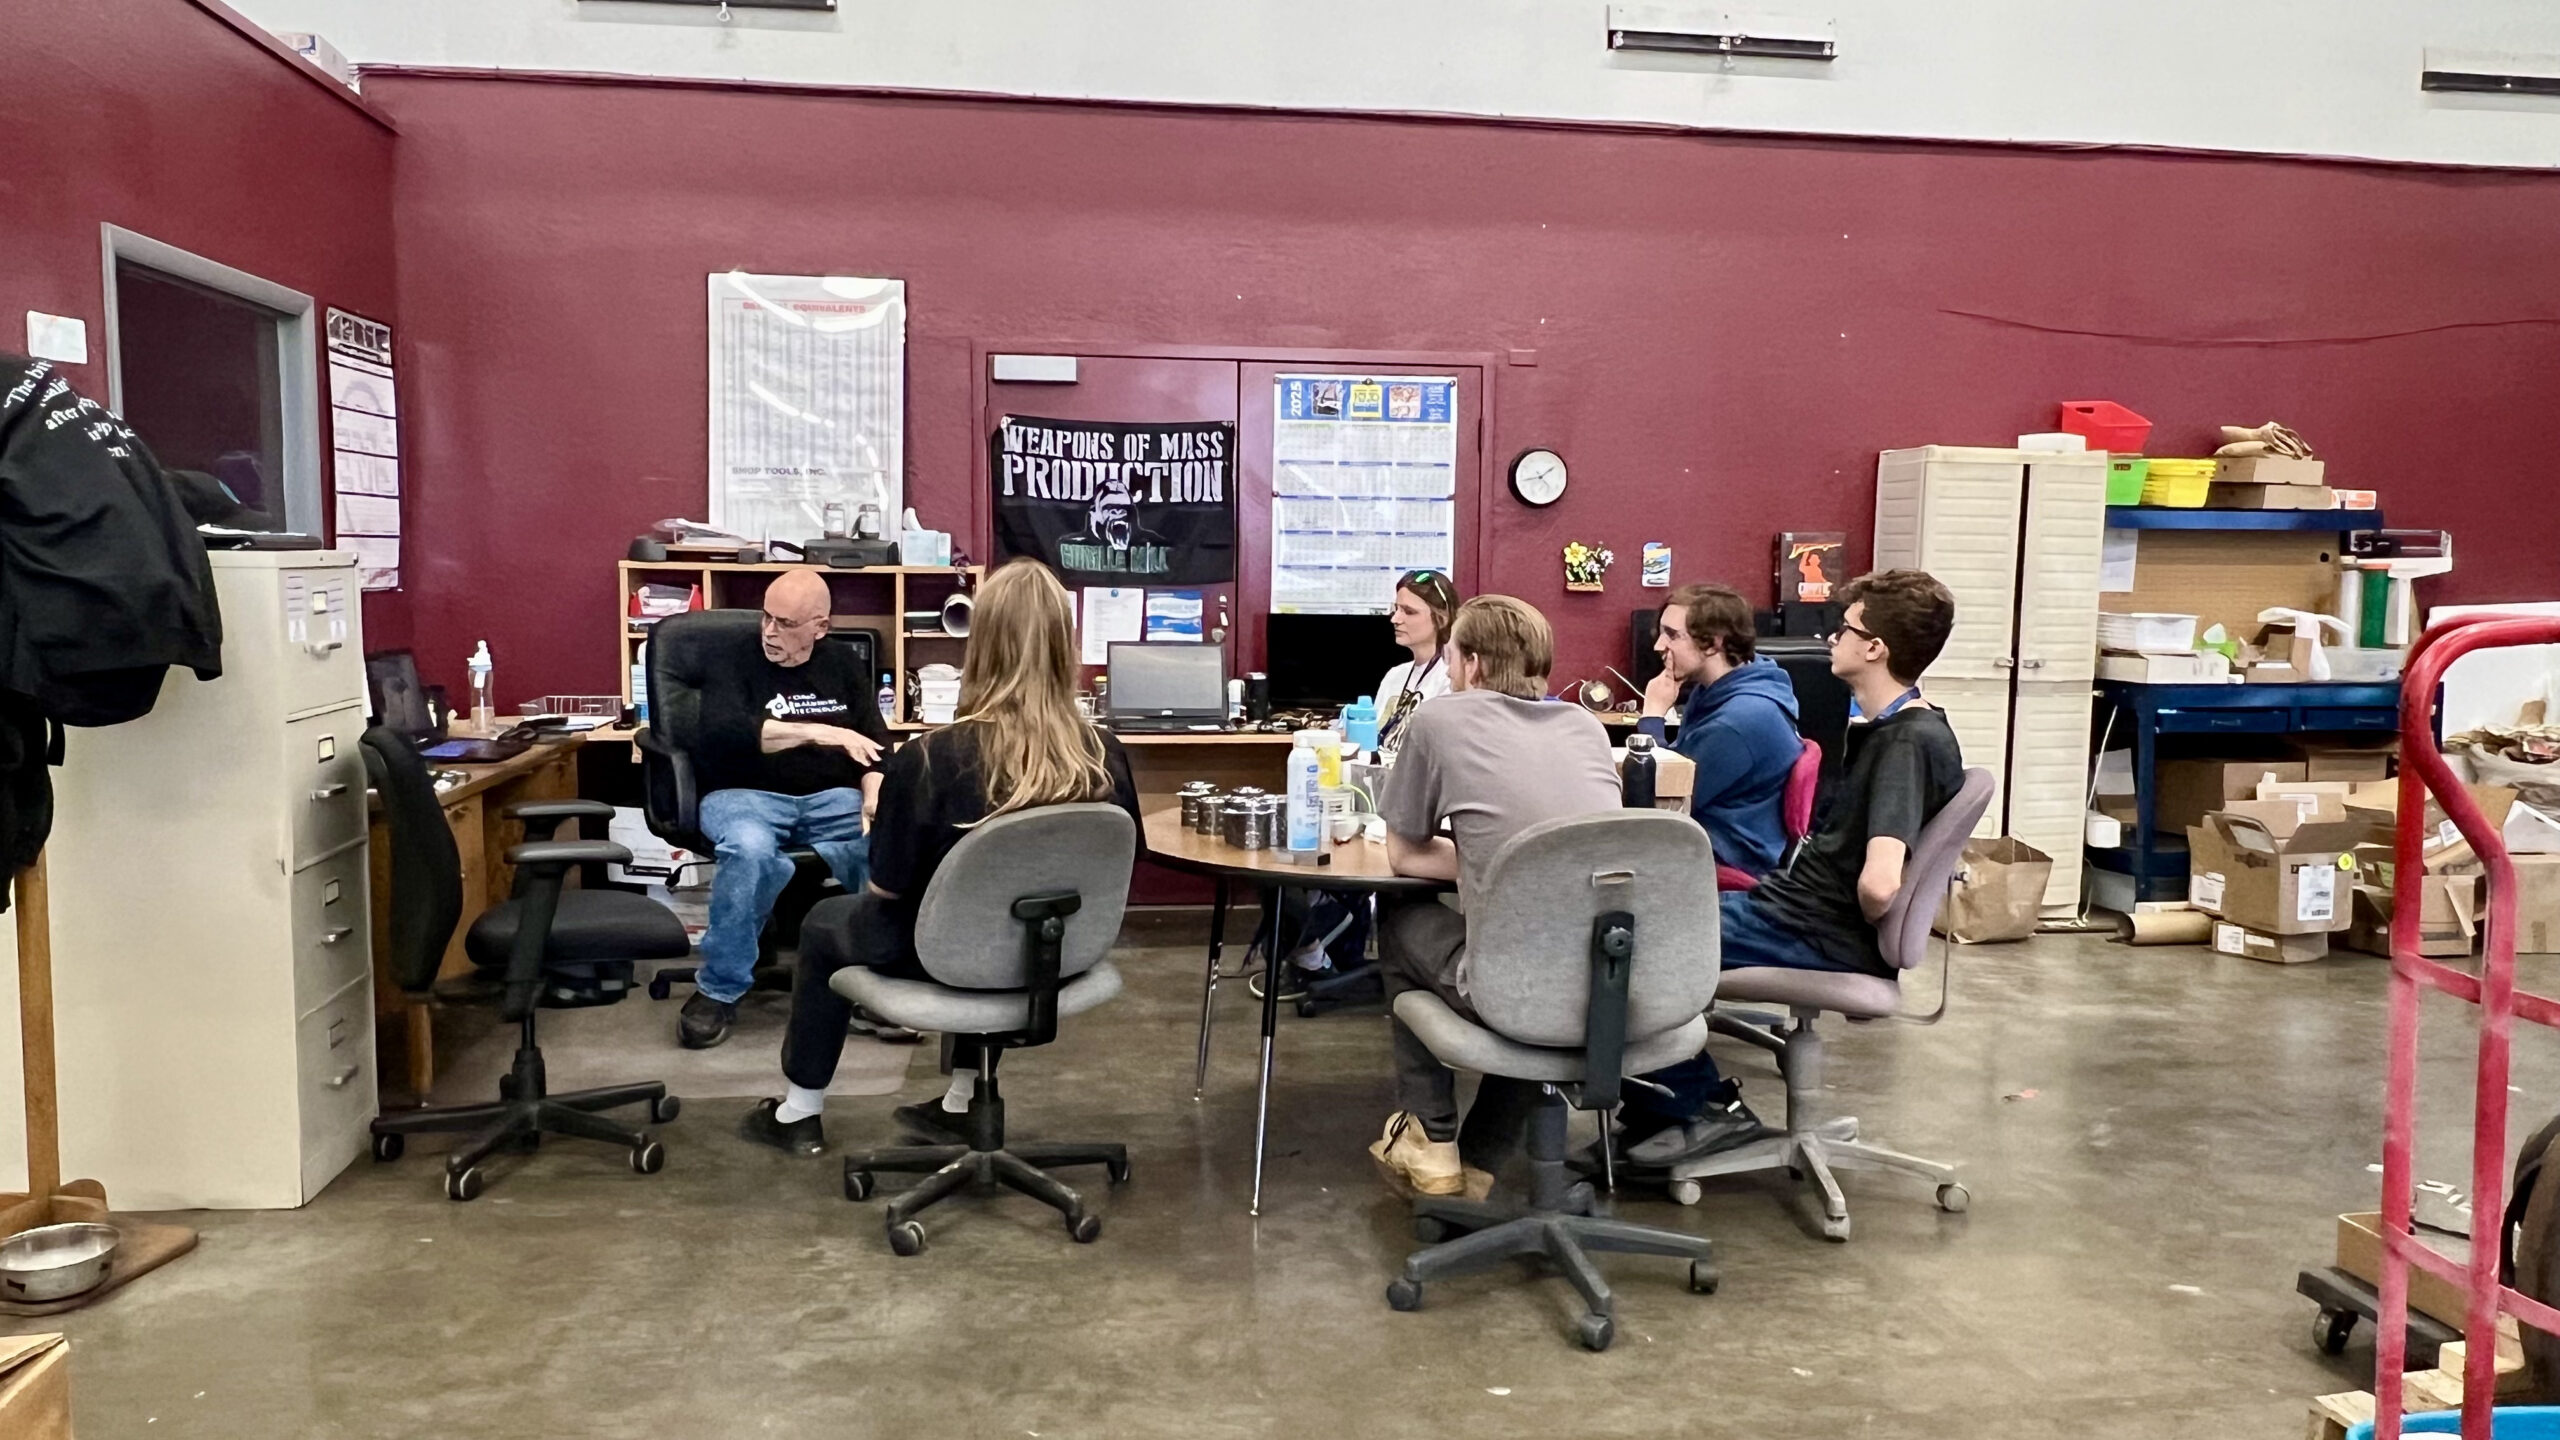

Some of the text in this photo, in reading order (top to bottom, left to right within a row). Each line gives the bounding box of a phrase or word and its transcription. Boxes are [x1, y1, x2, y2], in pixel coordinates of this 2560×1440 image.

[1290, 381, 1302, 417] 2025
[45, 407, 79, 430] after
[1002, 426, 1225, 461] WEAPONS OF MASS
[1002, 454, 1224, 503] PRODUCTION
